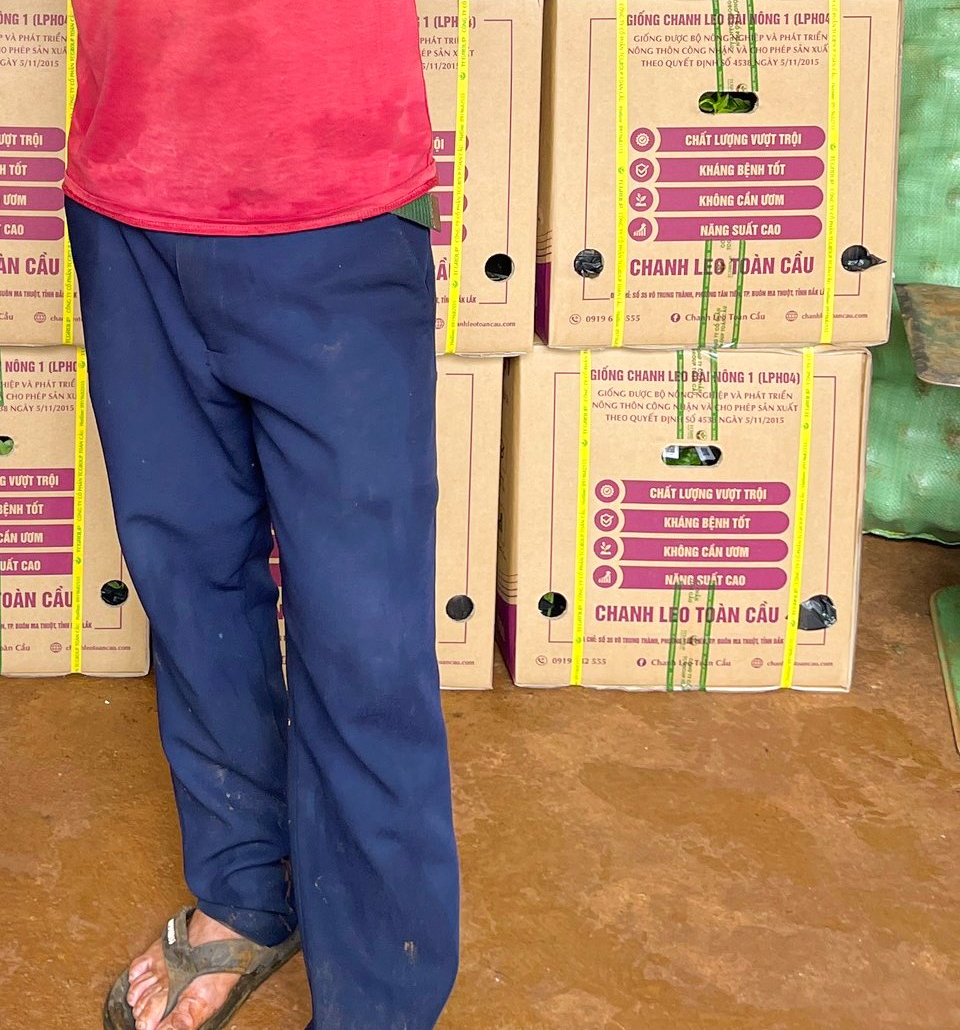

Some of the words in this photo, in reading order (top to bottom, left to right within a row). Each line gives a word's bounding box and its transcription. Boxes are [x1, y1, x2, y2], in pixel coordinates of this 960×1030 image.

[685, 131, 712, 146] CHẤT
[714, 133, 748, 148] LƯỢNG
[751, 133, 777, 147] VƯỢT
[779, 131, 802, 147] TRỘI
[9, 161, 28, 176] TỐT
[3, 193, 27, 206] ƯƠM
[700, 223, 729, 236] NĂNG
[732, 221, 758, 236] SUẤT
[761, 224, 781, 235] CAO
[26, 500, 44, 514] TỐT
[664, 515, 699, 528] KHÁNG
[702, 516, 730, 530] BỆNH
[732, 514, 751, 529] TỐT
[664, 544, 699, 557] KHÔNG
[701, 543, 723, 557] CẦN
[725, 546, 749, 557] ƯƠM
